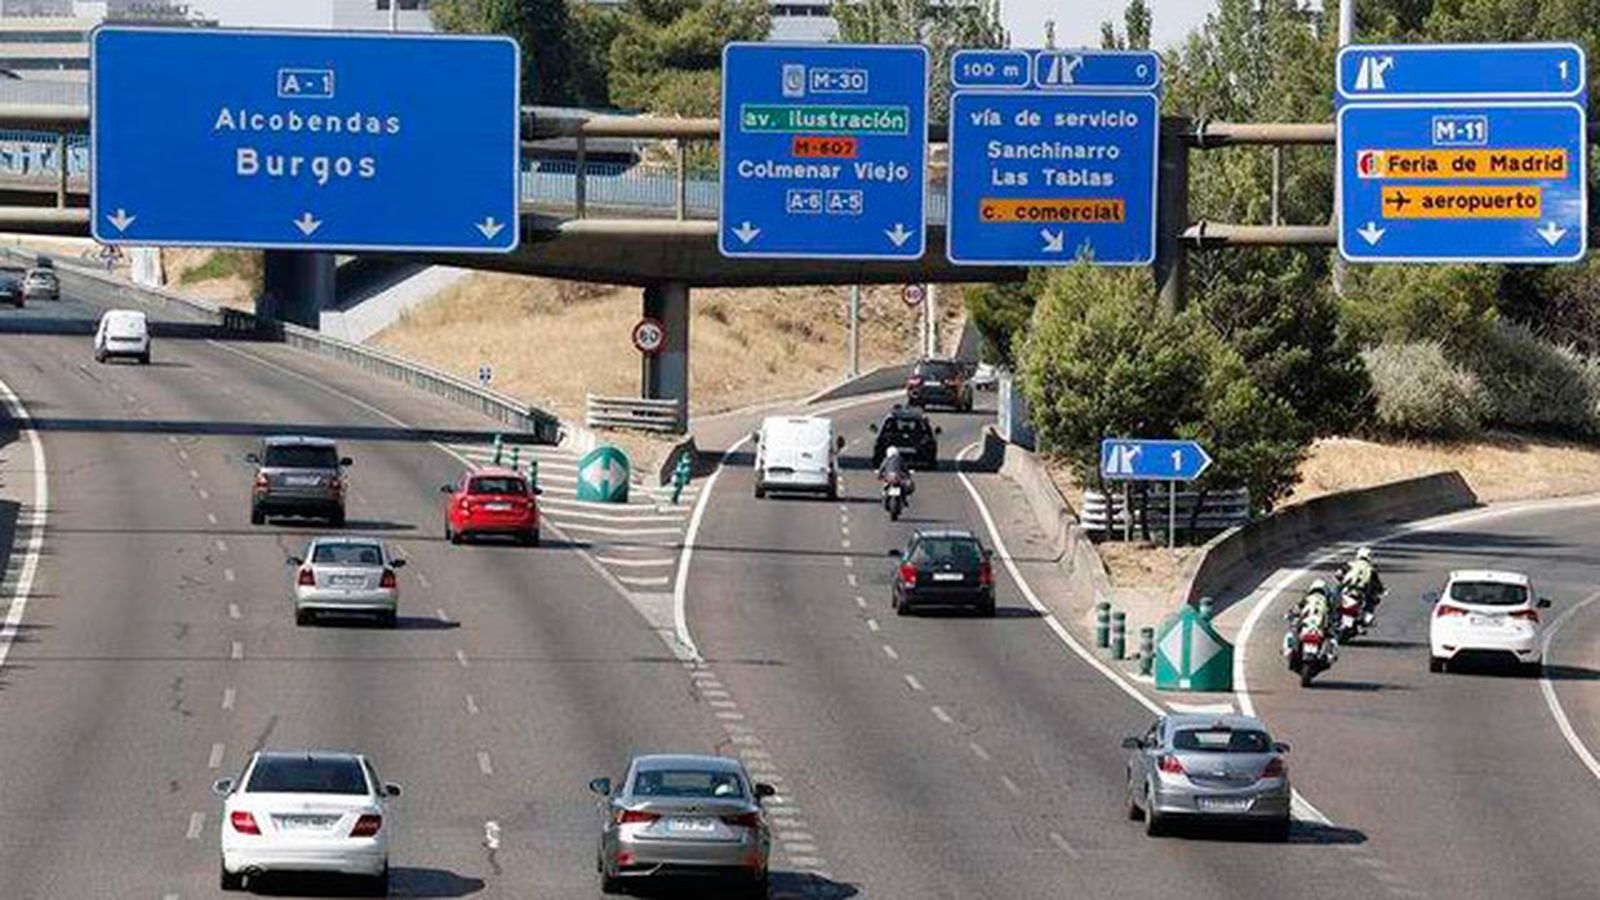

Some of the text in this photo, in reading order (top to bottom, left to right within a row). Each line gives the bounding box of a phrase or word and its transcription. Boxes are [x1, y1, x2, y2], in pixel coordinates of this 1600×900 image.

[963, 63, 1019, 77] 100 m
[1136, 64, 1148, 78] 0
[1559, 60, 1567, 79] 1
[814, 73, 863, 88] M-30
[214, 108, 400, 133] Alcobendas
[745, 110, 904, 128] av. ilustración
[971, 109, 1138, 126] vía de servicio
[1436, 122, 1484, 140] M-11
[795, 140, 854, 155] M-607
[987, 140, 1120, 159] Sanchinarro
[236, 148, 376, 184] Burgos
[737, 159, 909, 182] Colmenar Viejo
[1389, 155, 1563, 172] Feria de Madrid
[992, 169, 1114, 186] Las Tablas
[790, 195, 819, 209] A-6
[829, 195, 860, 209] A-5
[1422, 192, 1537, 212] aeropuerto
[982, 203, 1121, 220] c. comercial
[1171, 450, 1181, 471] 1
